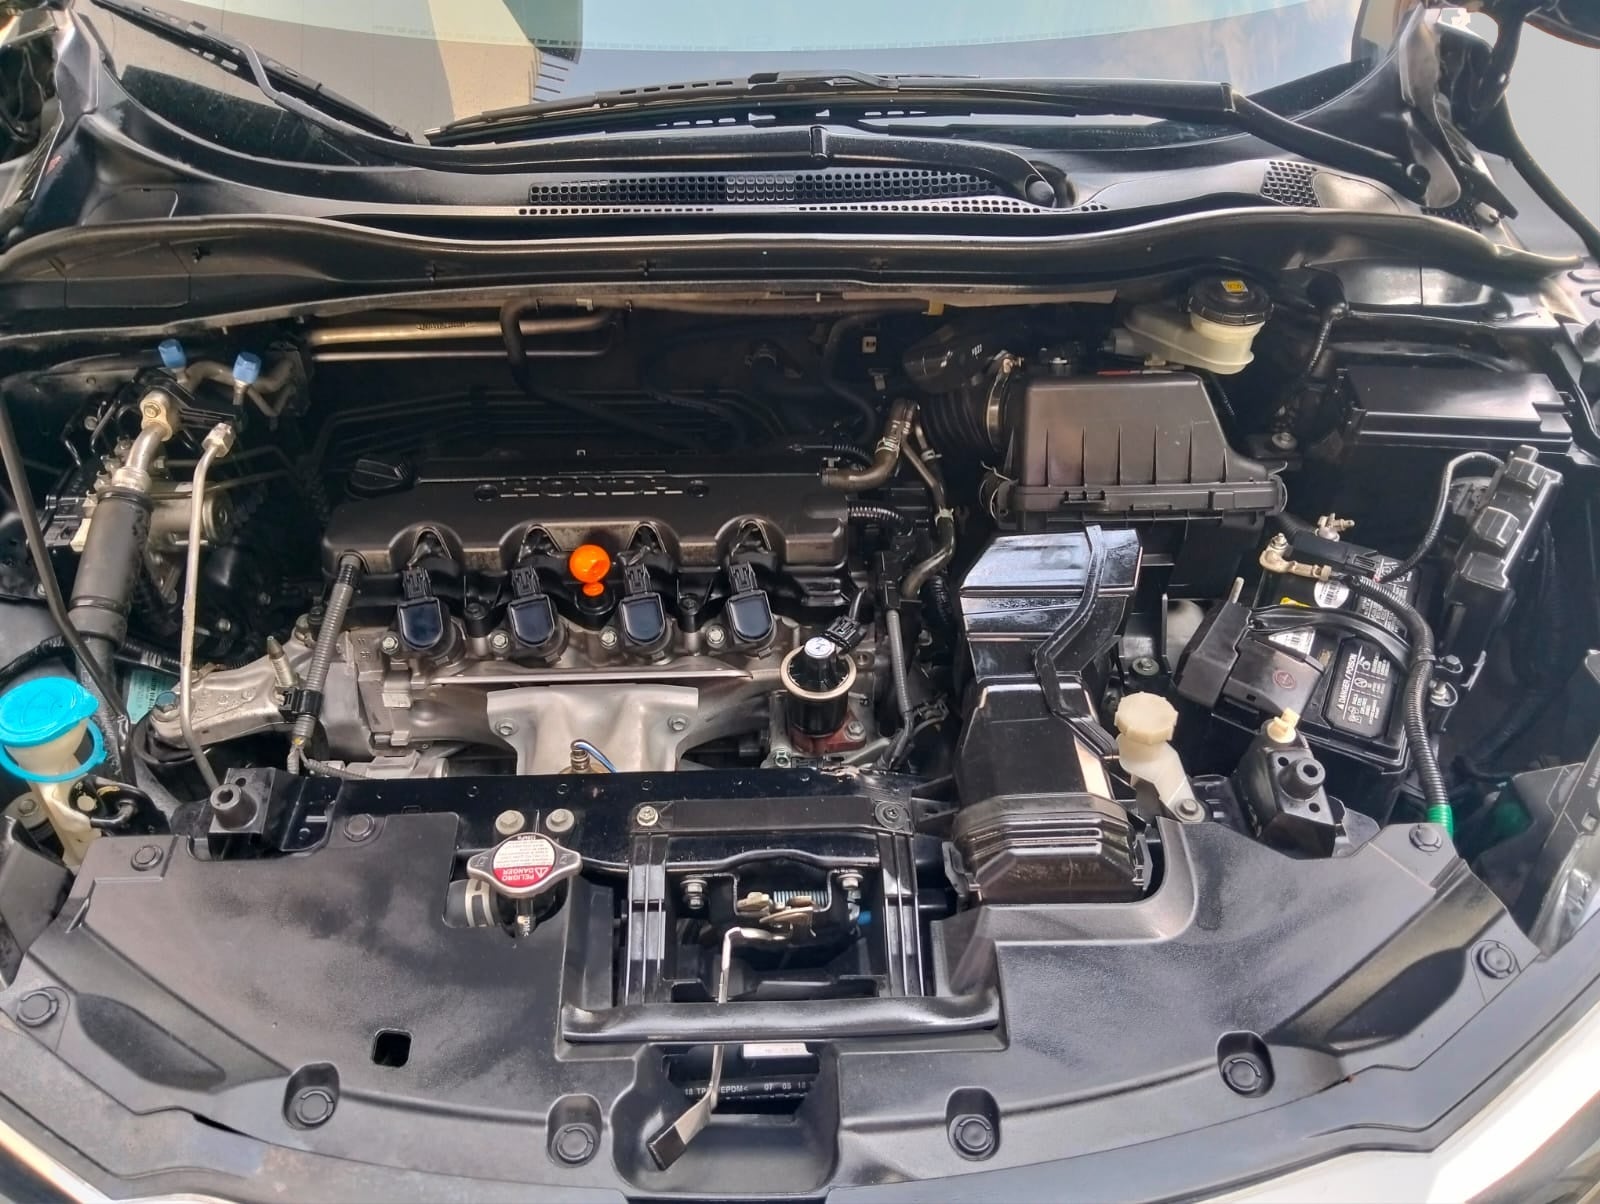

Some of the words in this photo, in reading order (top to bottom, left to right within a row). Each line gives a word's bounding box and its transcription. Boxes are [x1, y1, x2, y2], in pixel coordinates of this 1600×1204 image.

[1338, 679, 1351, 704] DANGER
[1345, 653, 1358, 675] POISON
[501, 873, 535, 881] PELIGRO
